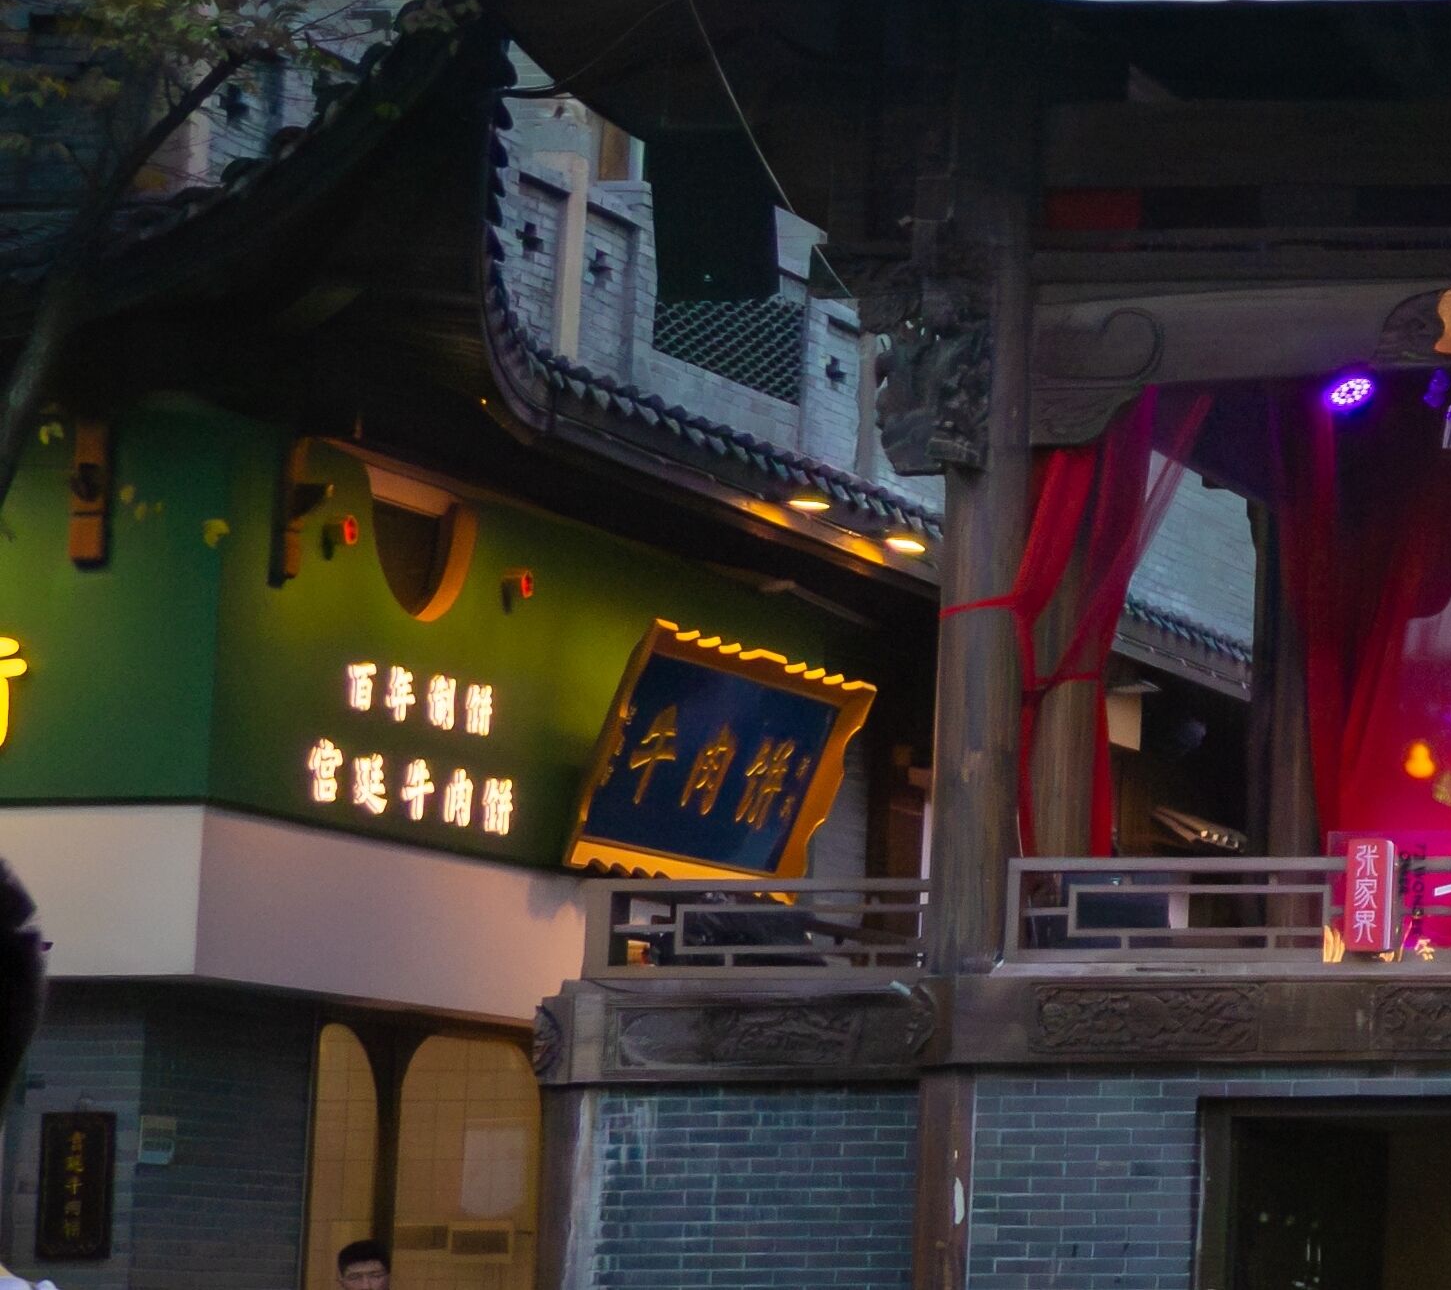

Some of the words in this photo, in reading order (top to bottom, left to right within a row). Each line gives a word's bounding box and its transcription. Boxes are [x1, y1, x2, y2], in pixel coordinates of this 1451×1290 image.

[307, 737, 514, 836] 宫廷牛肉饼
[1353, 844, 1379, 944] 张家界
